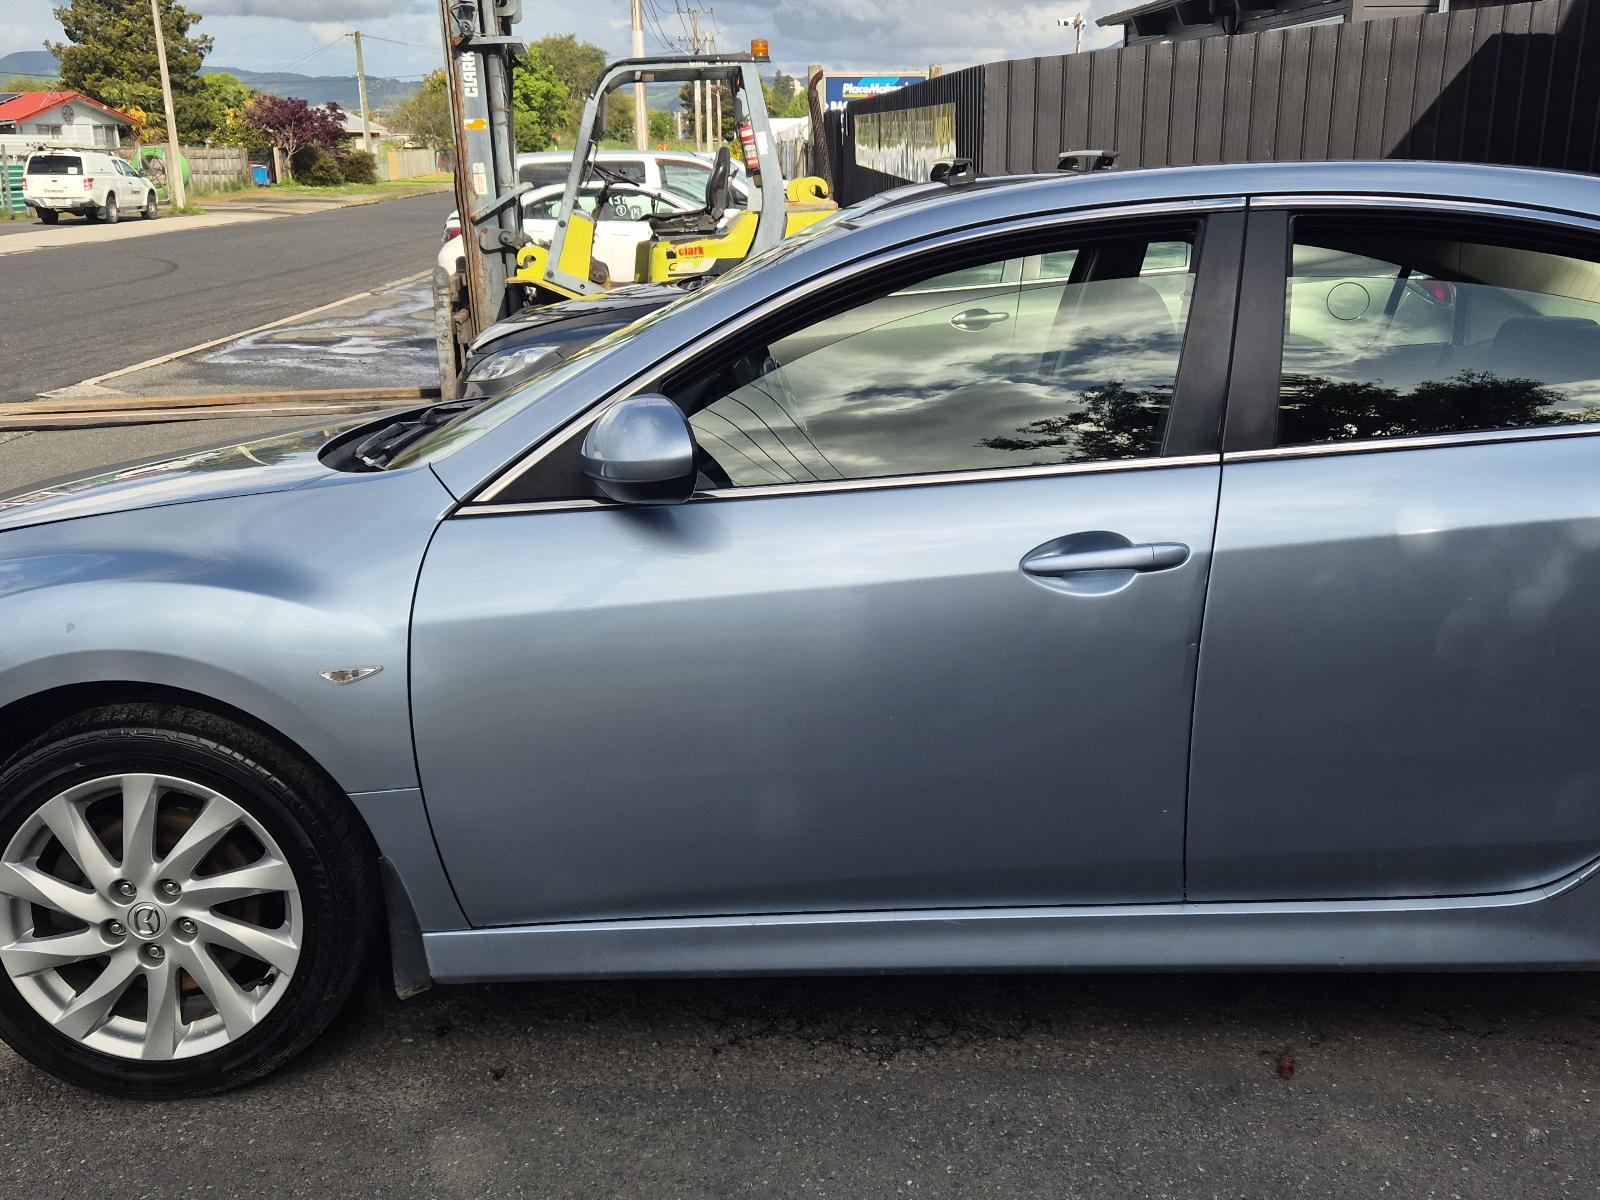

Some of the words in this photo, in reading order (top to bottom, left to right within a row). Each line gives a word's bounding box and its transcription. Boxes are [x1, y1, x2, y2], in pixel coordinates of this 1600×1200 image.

[461, 51, 478, 97] CLARK
[843, 82, 903, 94] PlaceMake
[678, 245, 704, 256] clark
